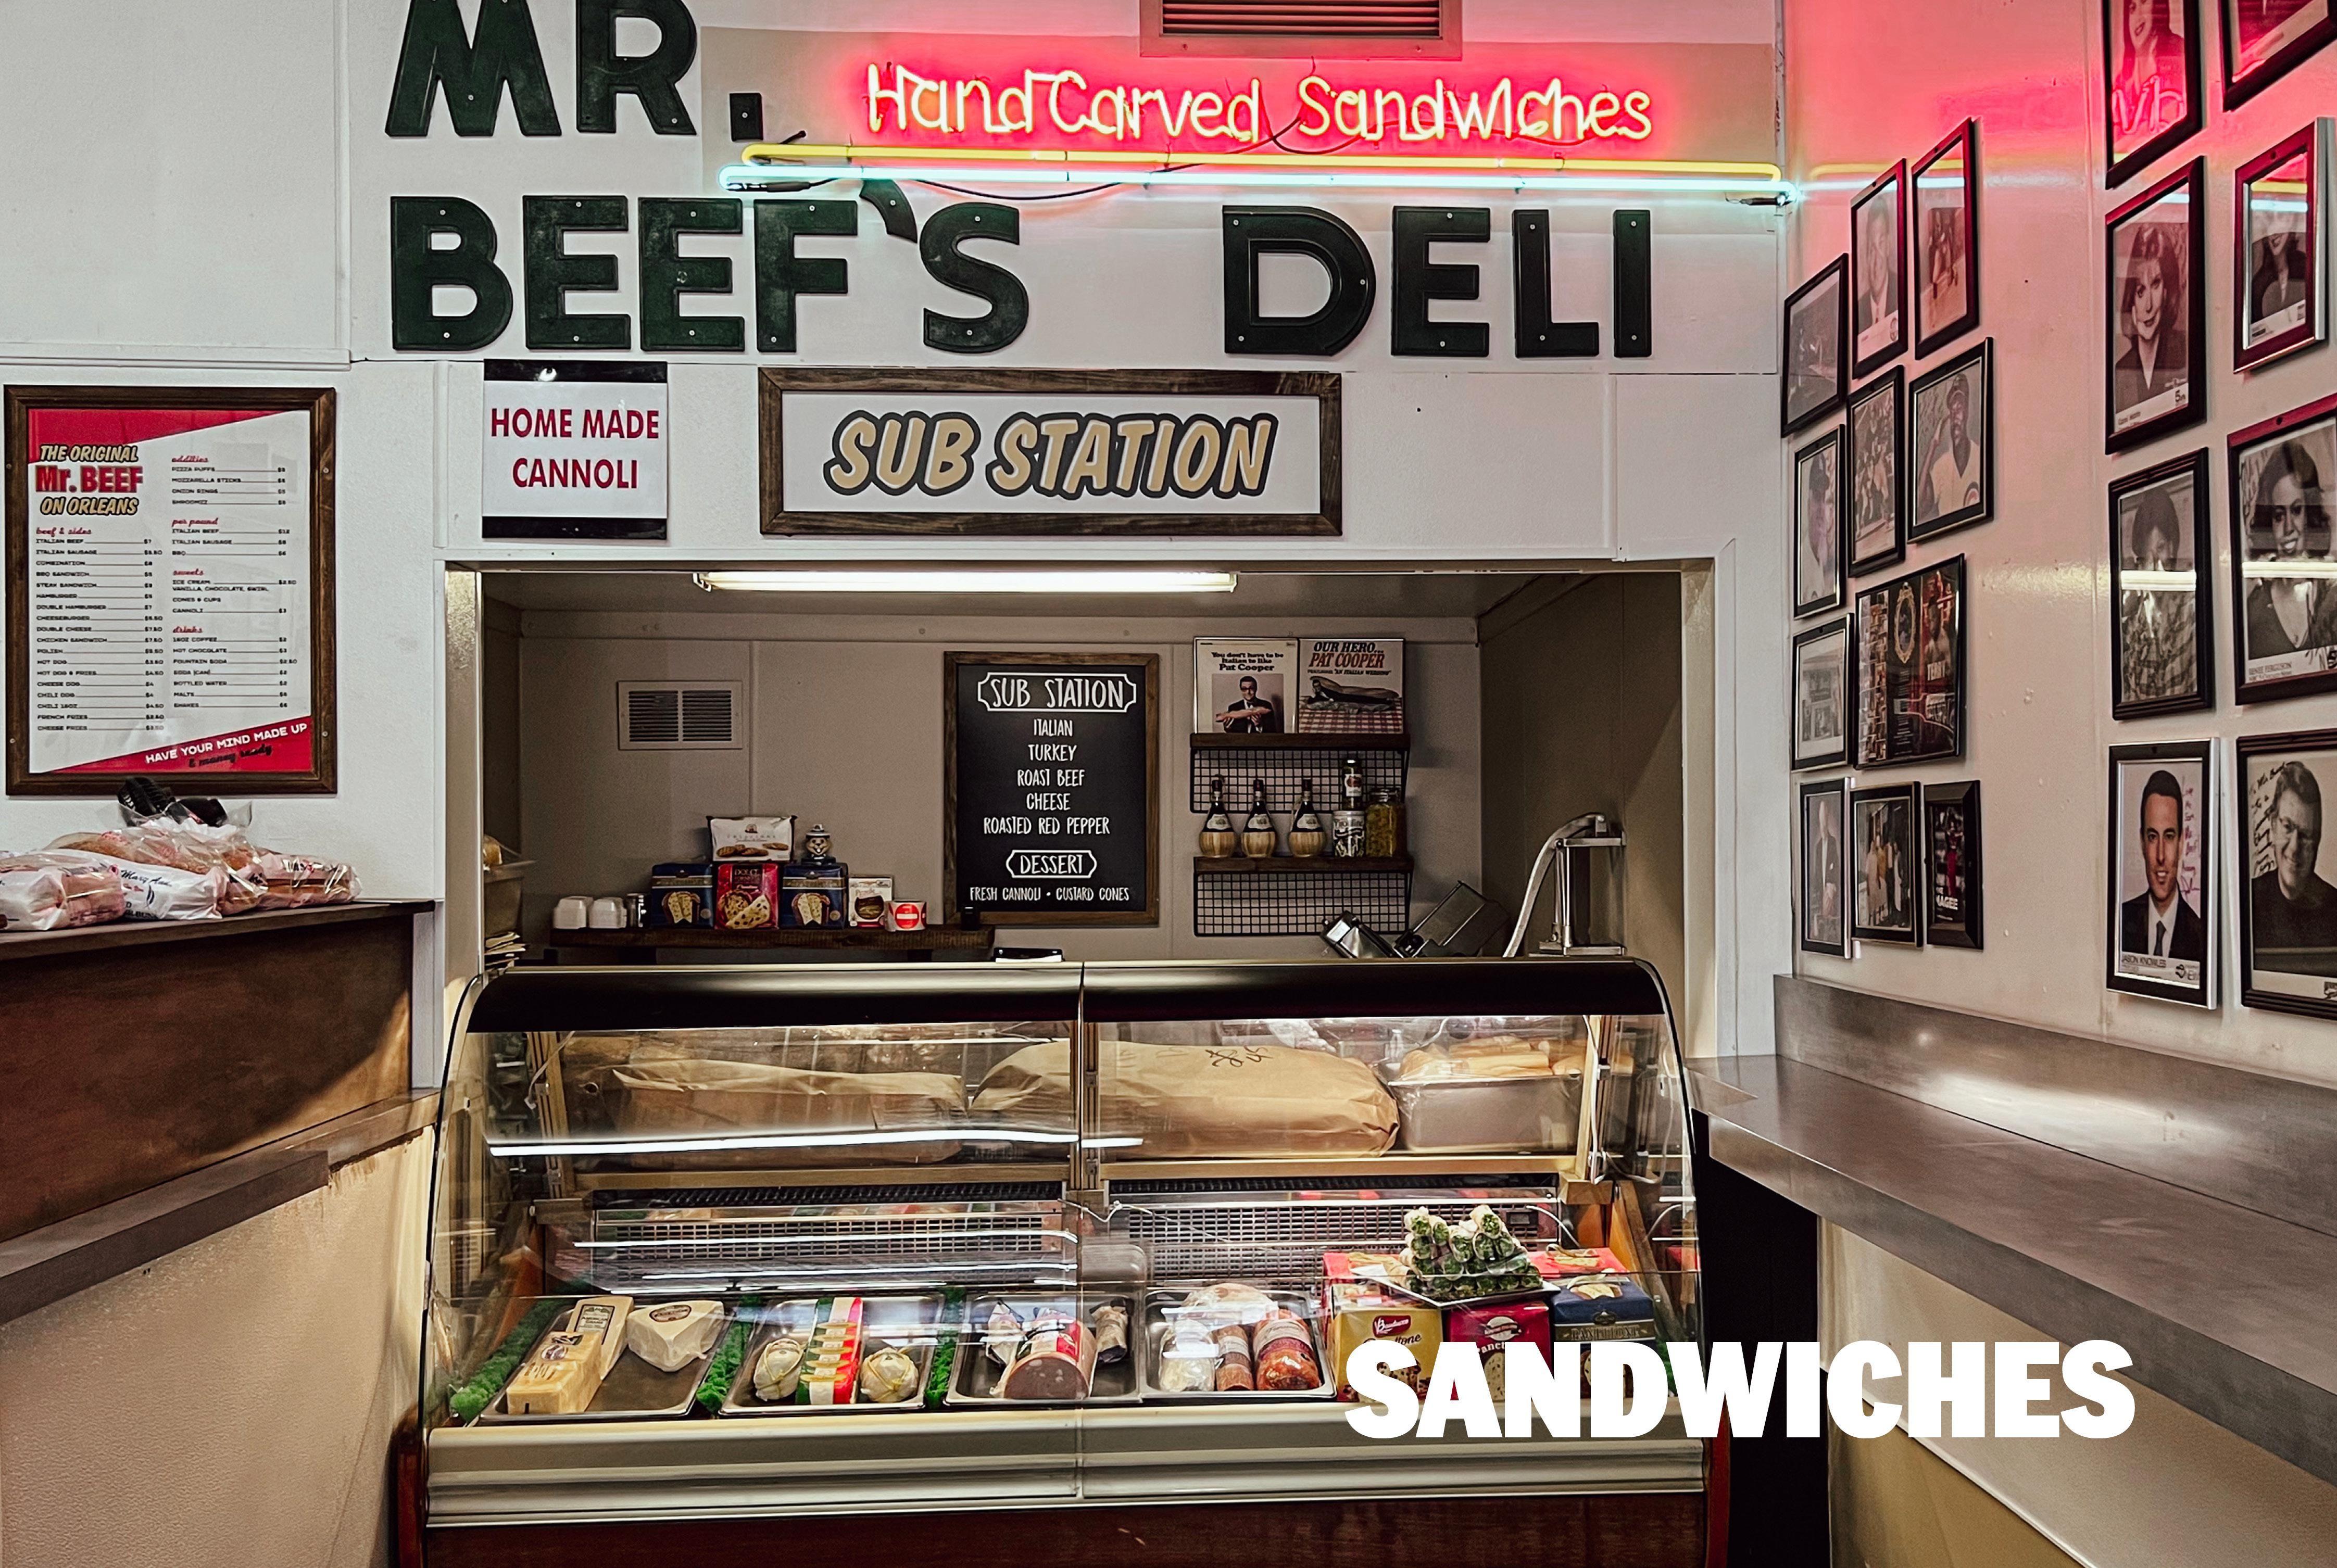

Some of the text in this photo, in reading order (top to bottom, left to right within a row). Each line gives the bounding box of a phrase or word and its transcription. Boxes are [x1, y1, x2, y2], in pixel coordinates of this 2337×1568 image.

[385, 0, 763, 142] MR.
[390, 179, 1652, 358] BEEF'S DELI
[492, 408, 659, 439] HOME MADE
[40, 444, 139, 463] THE ORIGINAL
[823, 410, 1278, 500] SUB STATION
[35, 465, 144, 493] Mr. BEEF
[512, 458, 637, 488] CANNOLI
[40, 496, 139, 516] ON ORLEANS
[1313, 641, 1340, 653] OUR
[1237, 664, 1275, 673] Cooper
[1309, 652, 1385, 668] PAT COOPER
[990, 678, 1125, 709] SUB STATION
[1033, 718, 1073, 737] ITALIAN
[146, 723, 307, 763] HAVE YOUR MIND MADE UP
[1027, 744, 1077, 762] TURKEY
[1017, 769, 1085, 787] ROAST BEEF
[1026, 793, 1071, 811] CHEESE
[983, 817, 1110, 835] ROASTED RED PEPPER
[1020, 855, 1084, 875] DESSERT
[970, 887, 1129, 901] FRESH CANNOLI CUSTARD CONES
